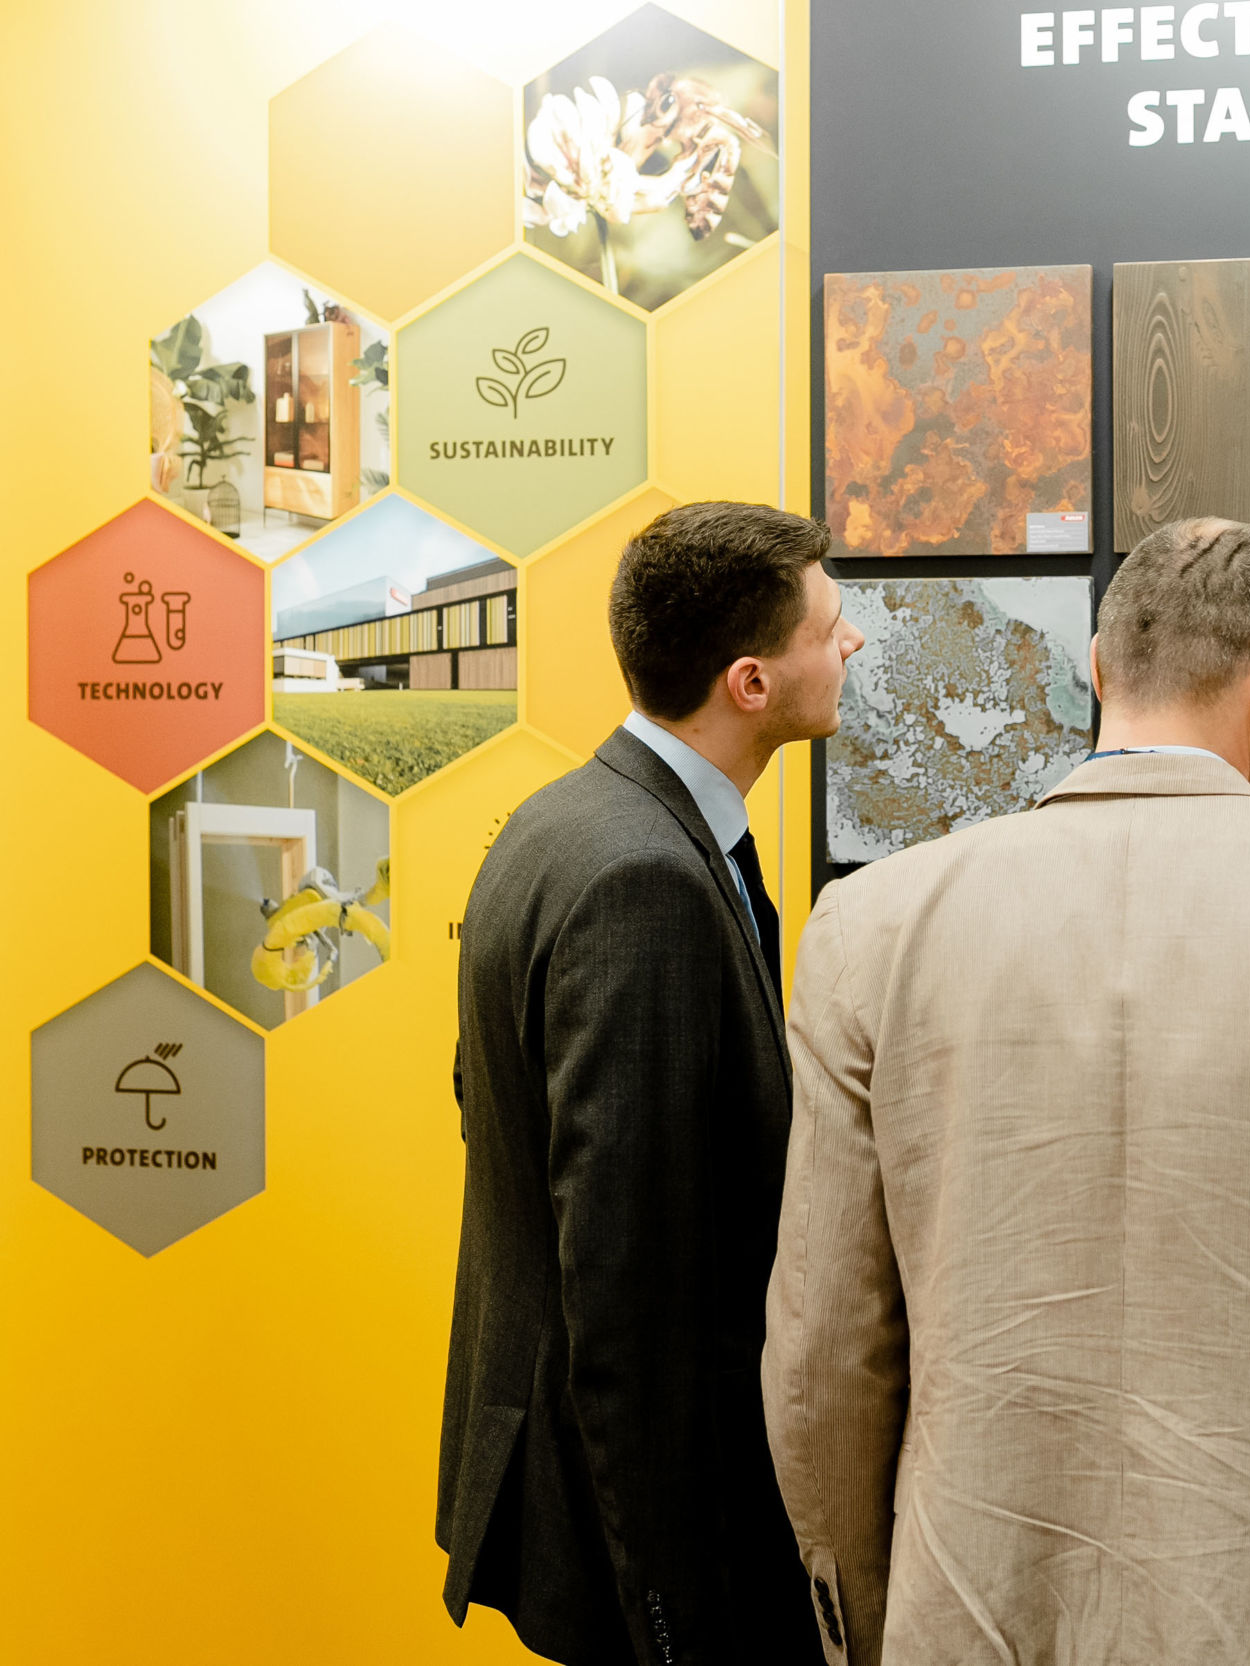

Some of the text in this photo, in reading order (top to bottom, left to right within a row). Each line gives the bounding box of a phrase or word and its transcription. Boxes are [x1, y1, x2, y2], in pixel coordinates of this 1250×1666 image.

[429, 437, 615, 460] SUSTAINABILITY
[77, 682, 223, 700] TECHNOLOGY
[82, 1147, 217, 1170] PROTECTION
